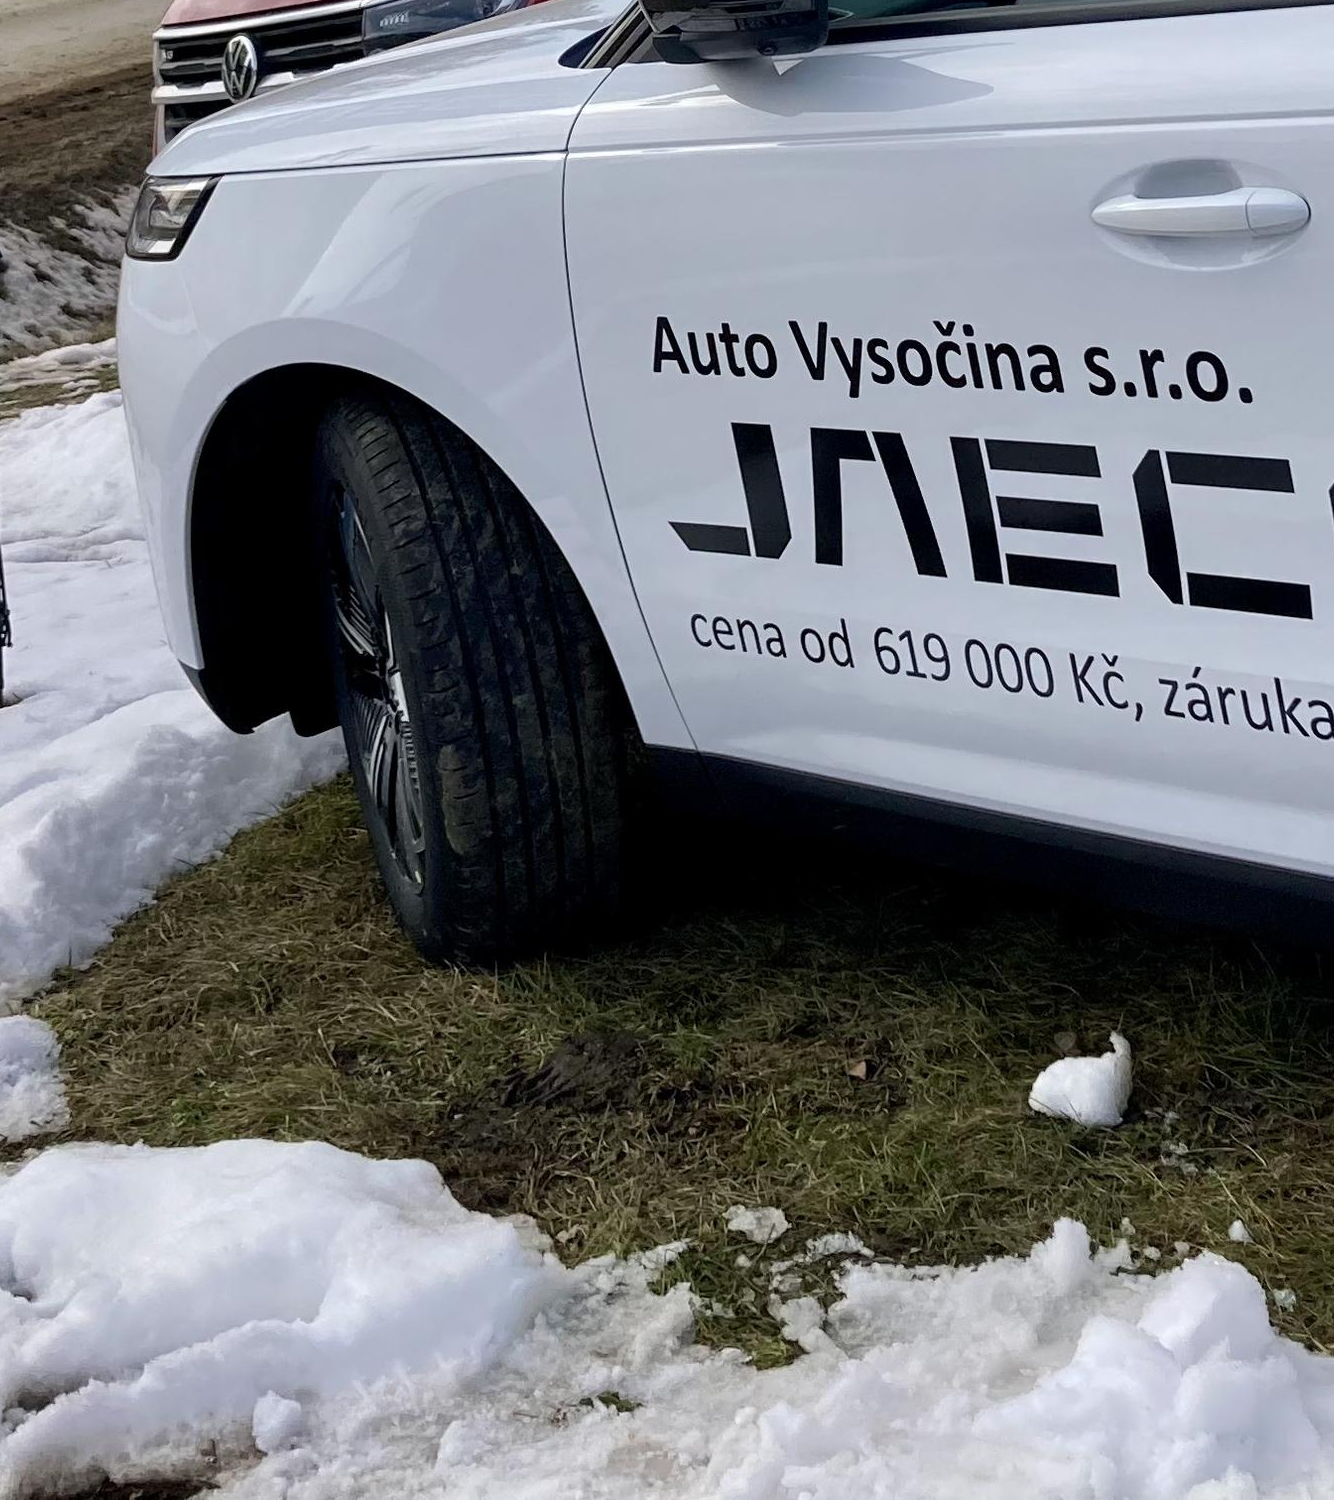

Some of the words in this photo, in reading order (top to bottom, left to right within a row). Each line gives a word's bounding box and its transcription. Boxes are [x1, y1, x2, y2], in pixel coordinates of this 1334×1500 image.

[652, 316, 778, 380] Auto
[789, 320, 1065, 398] Vysočina
[1083, 343, 1254, 404] s.r.o.
[690, 610, 788, 659] cena
[799, 618, 854, 670] od
[873, 626, 951, 682] 619
[964, 638, 1054, 698] 000
[1069, 652, 1144, 723] Kč,
